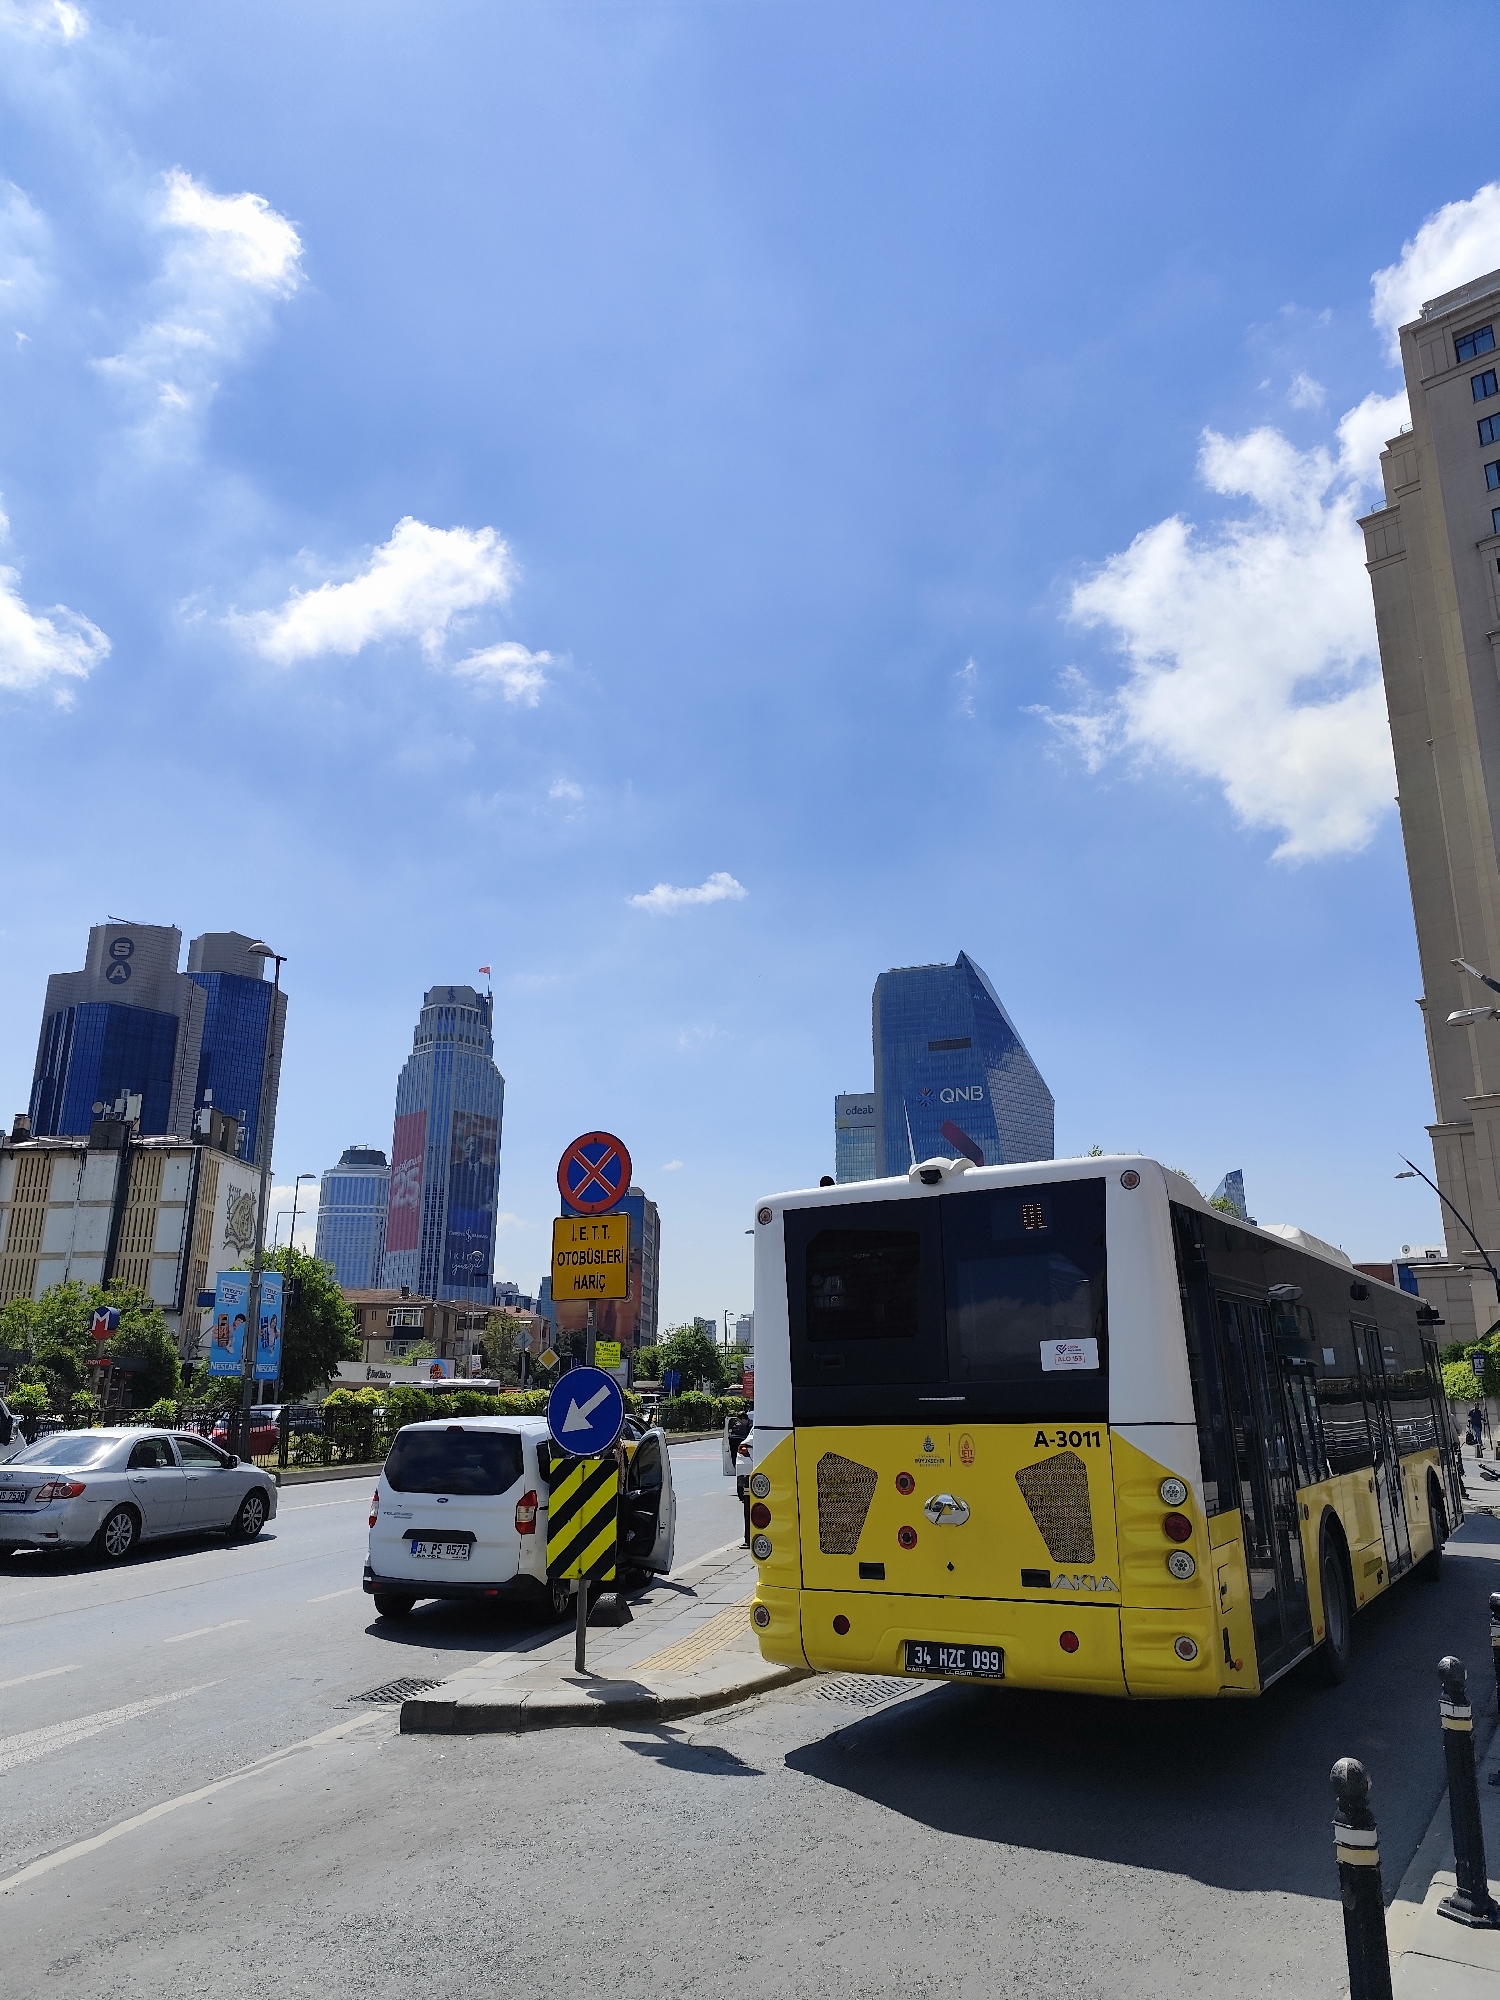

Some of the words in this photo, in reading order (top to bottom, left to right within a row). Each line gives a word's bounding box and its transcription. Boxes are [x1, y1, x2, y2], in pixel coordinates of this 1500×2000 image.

[939, 1085, 984, 1104] QNB
[845, 1105, 876, 1116] odeab
[557, 1245, 624, 1267] OTOBÜSLERİ
[573, 1271, 606, 1293] HARİÇ
[1033, 1430, 1101, 1448] A-3011
[418, 1542, 427, 1554] 34
[431, 1543, 443, 1555] PS
[914, 1646, 932, 1665] 34
[939, 1647, 966, 1668] HZC
[972, 1650, 999, 1671] 099
